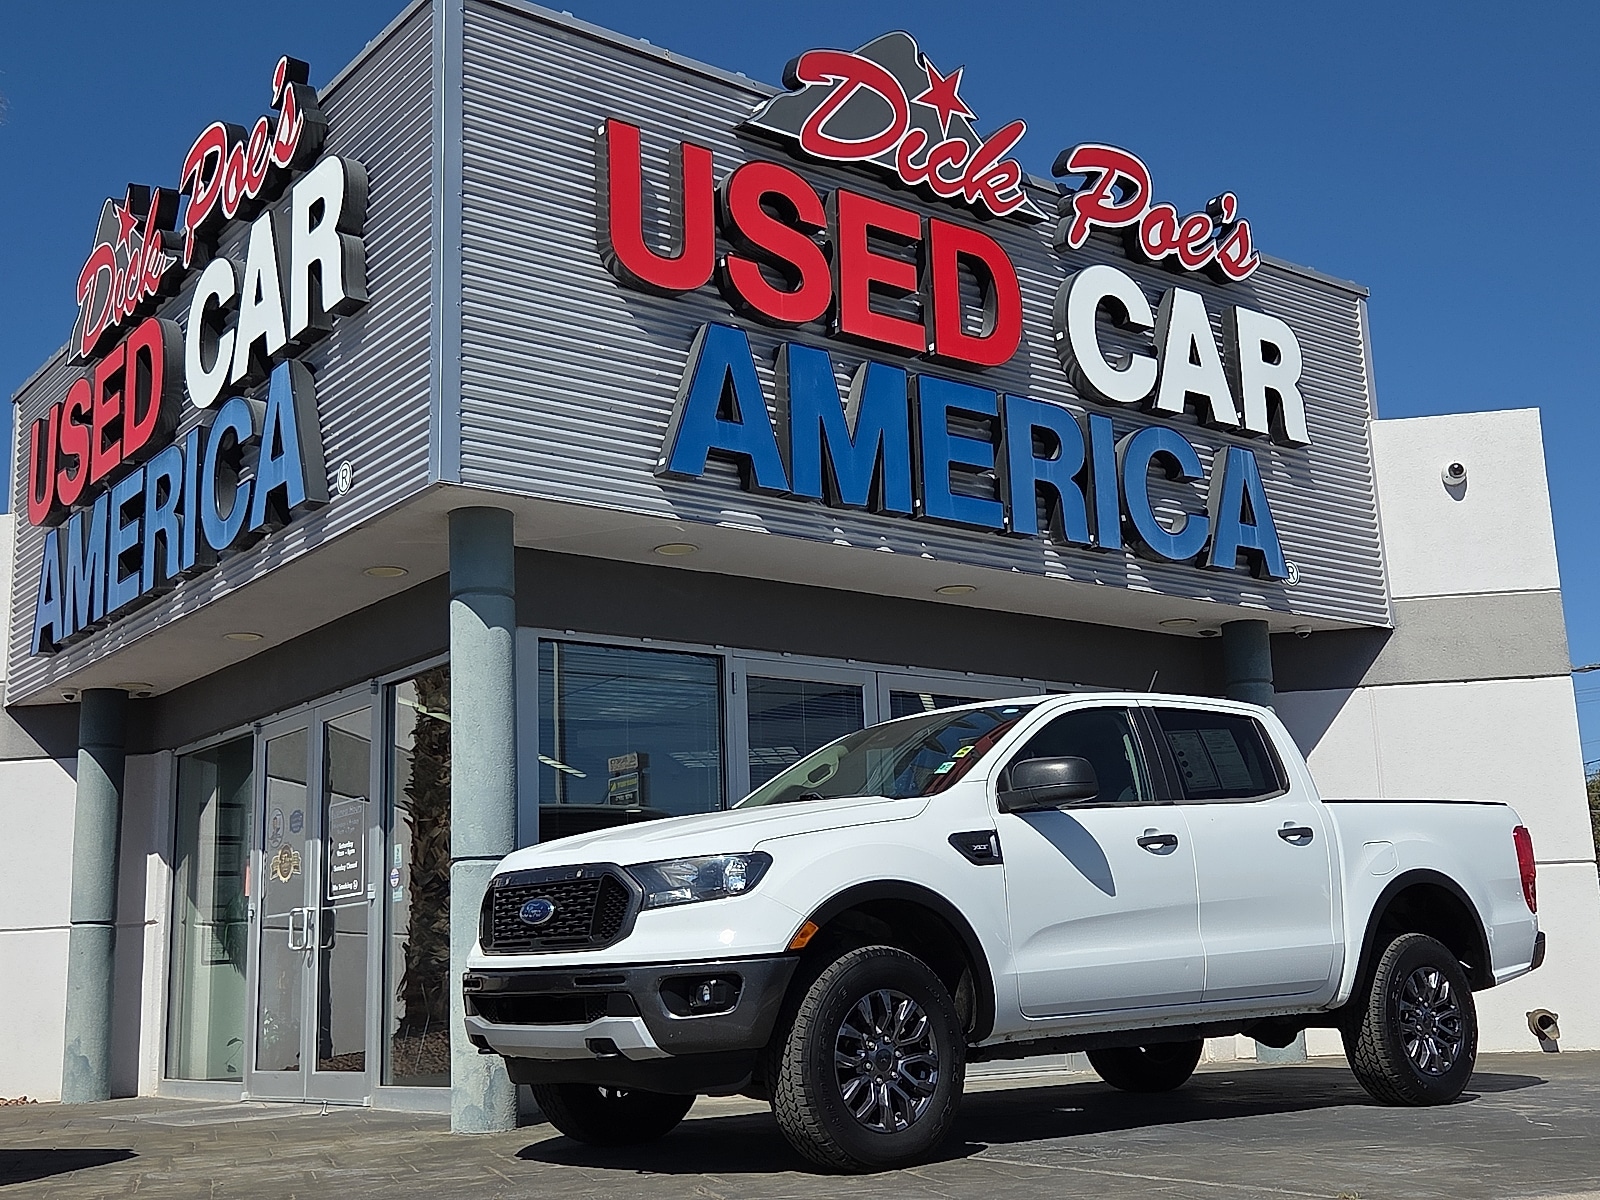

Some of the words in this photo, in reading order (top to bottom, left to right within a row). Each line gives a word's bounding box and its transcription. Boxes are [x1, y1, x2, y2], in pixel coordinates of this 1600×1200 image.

[77, 187, 165, 358] Dick
[179, 55, 304, 268] Poe's
[606, 118, 1023, 367] USED
[1066, 265, 1311, 446] CAR
[797, 50, 1027, 215] Dick
[1066, 144, 1260, 282] Poe's
[27, 317, 164, 527] USED
[185, 155, 346, 408] CAR
[667, 322, 1289, 581] AMERICA
[30, 359, 307, 657] AMERICA
